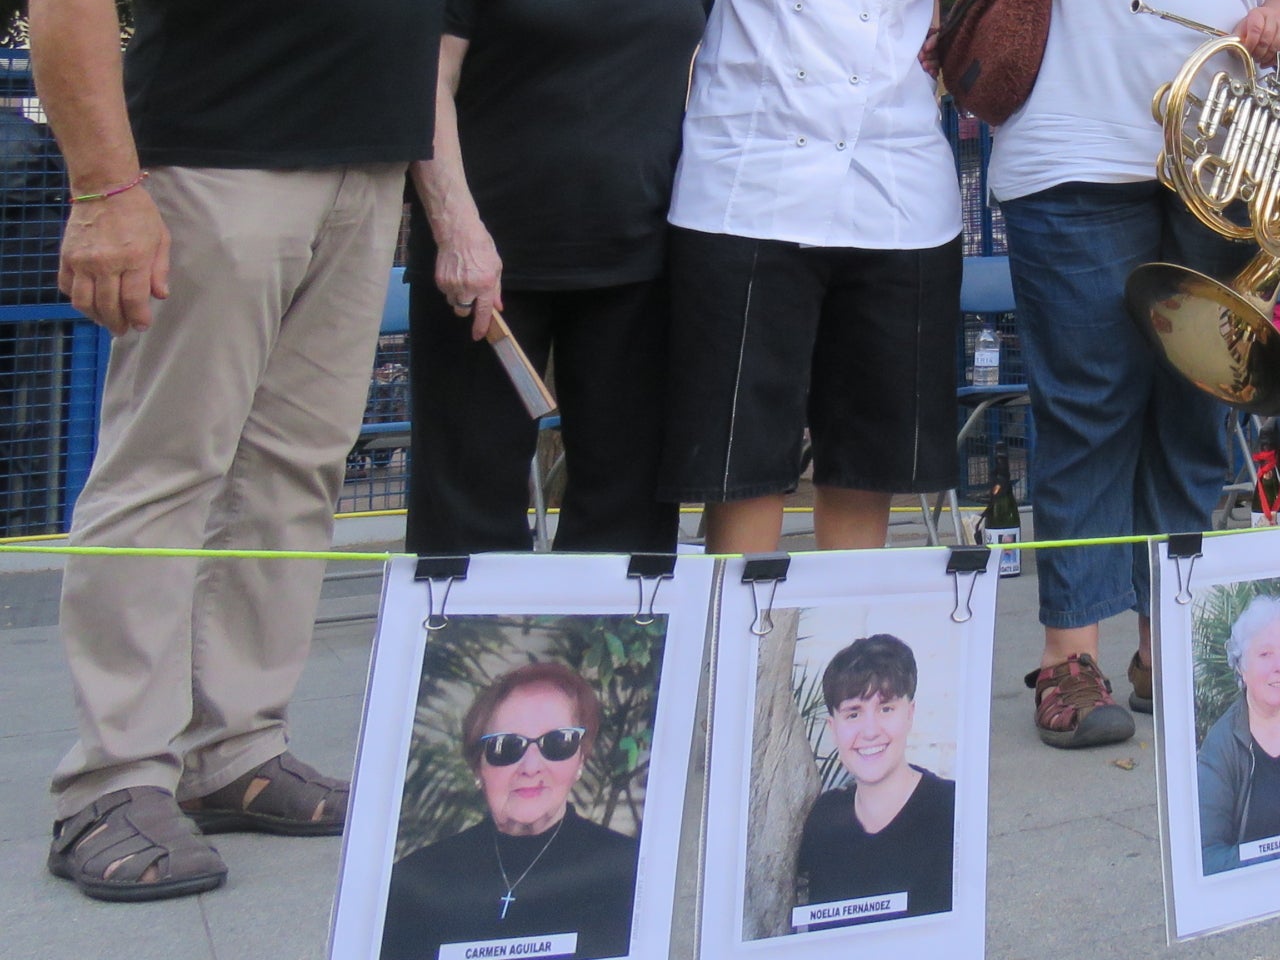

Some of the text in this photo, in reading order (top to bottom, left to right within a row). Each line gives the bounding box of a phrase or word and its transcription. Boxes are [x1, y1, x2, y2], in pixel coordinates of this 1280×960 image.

[810, 899, 891, 921] NOELIA FERNÁNDEZ
[465, 941, 552, 960] CARMEN AGUILAR
